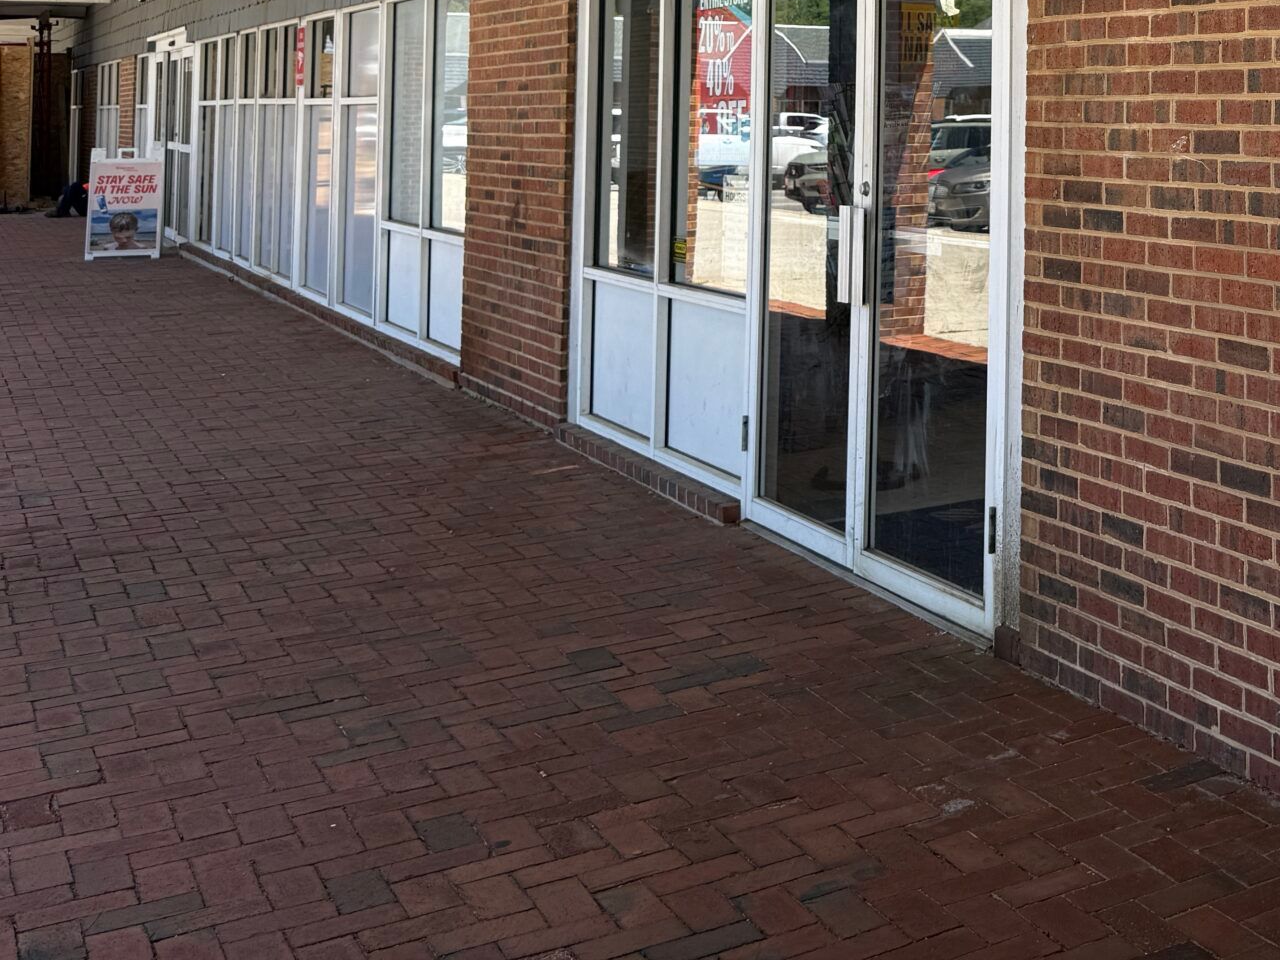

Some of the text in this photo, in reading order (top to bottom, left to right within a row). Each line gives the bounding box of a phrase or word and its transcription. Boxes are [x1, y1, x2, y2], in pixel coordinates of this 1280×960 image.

[698, 14, 725, 54] 20%
[706, 57, 735, 96] 40%
[94, 184, 158, 194] IN THE SUN
[97, 174, 156, 185] STAY SAFE
